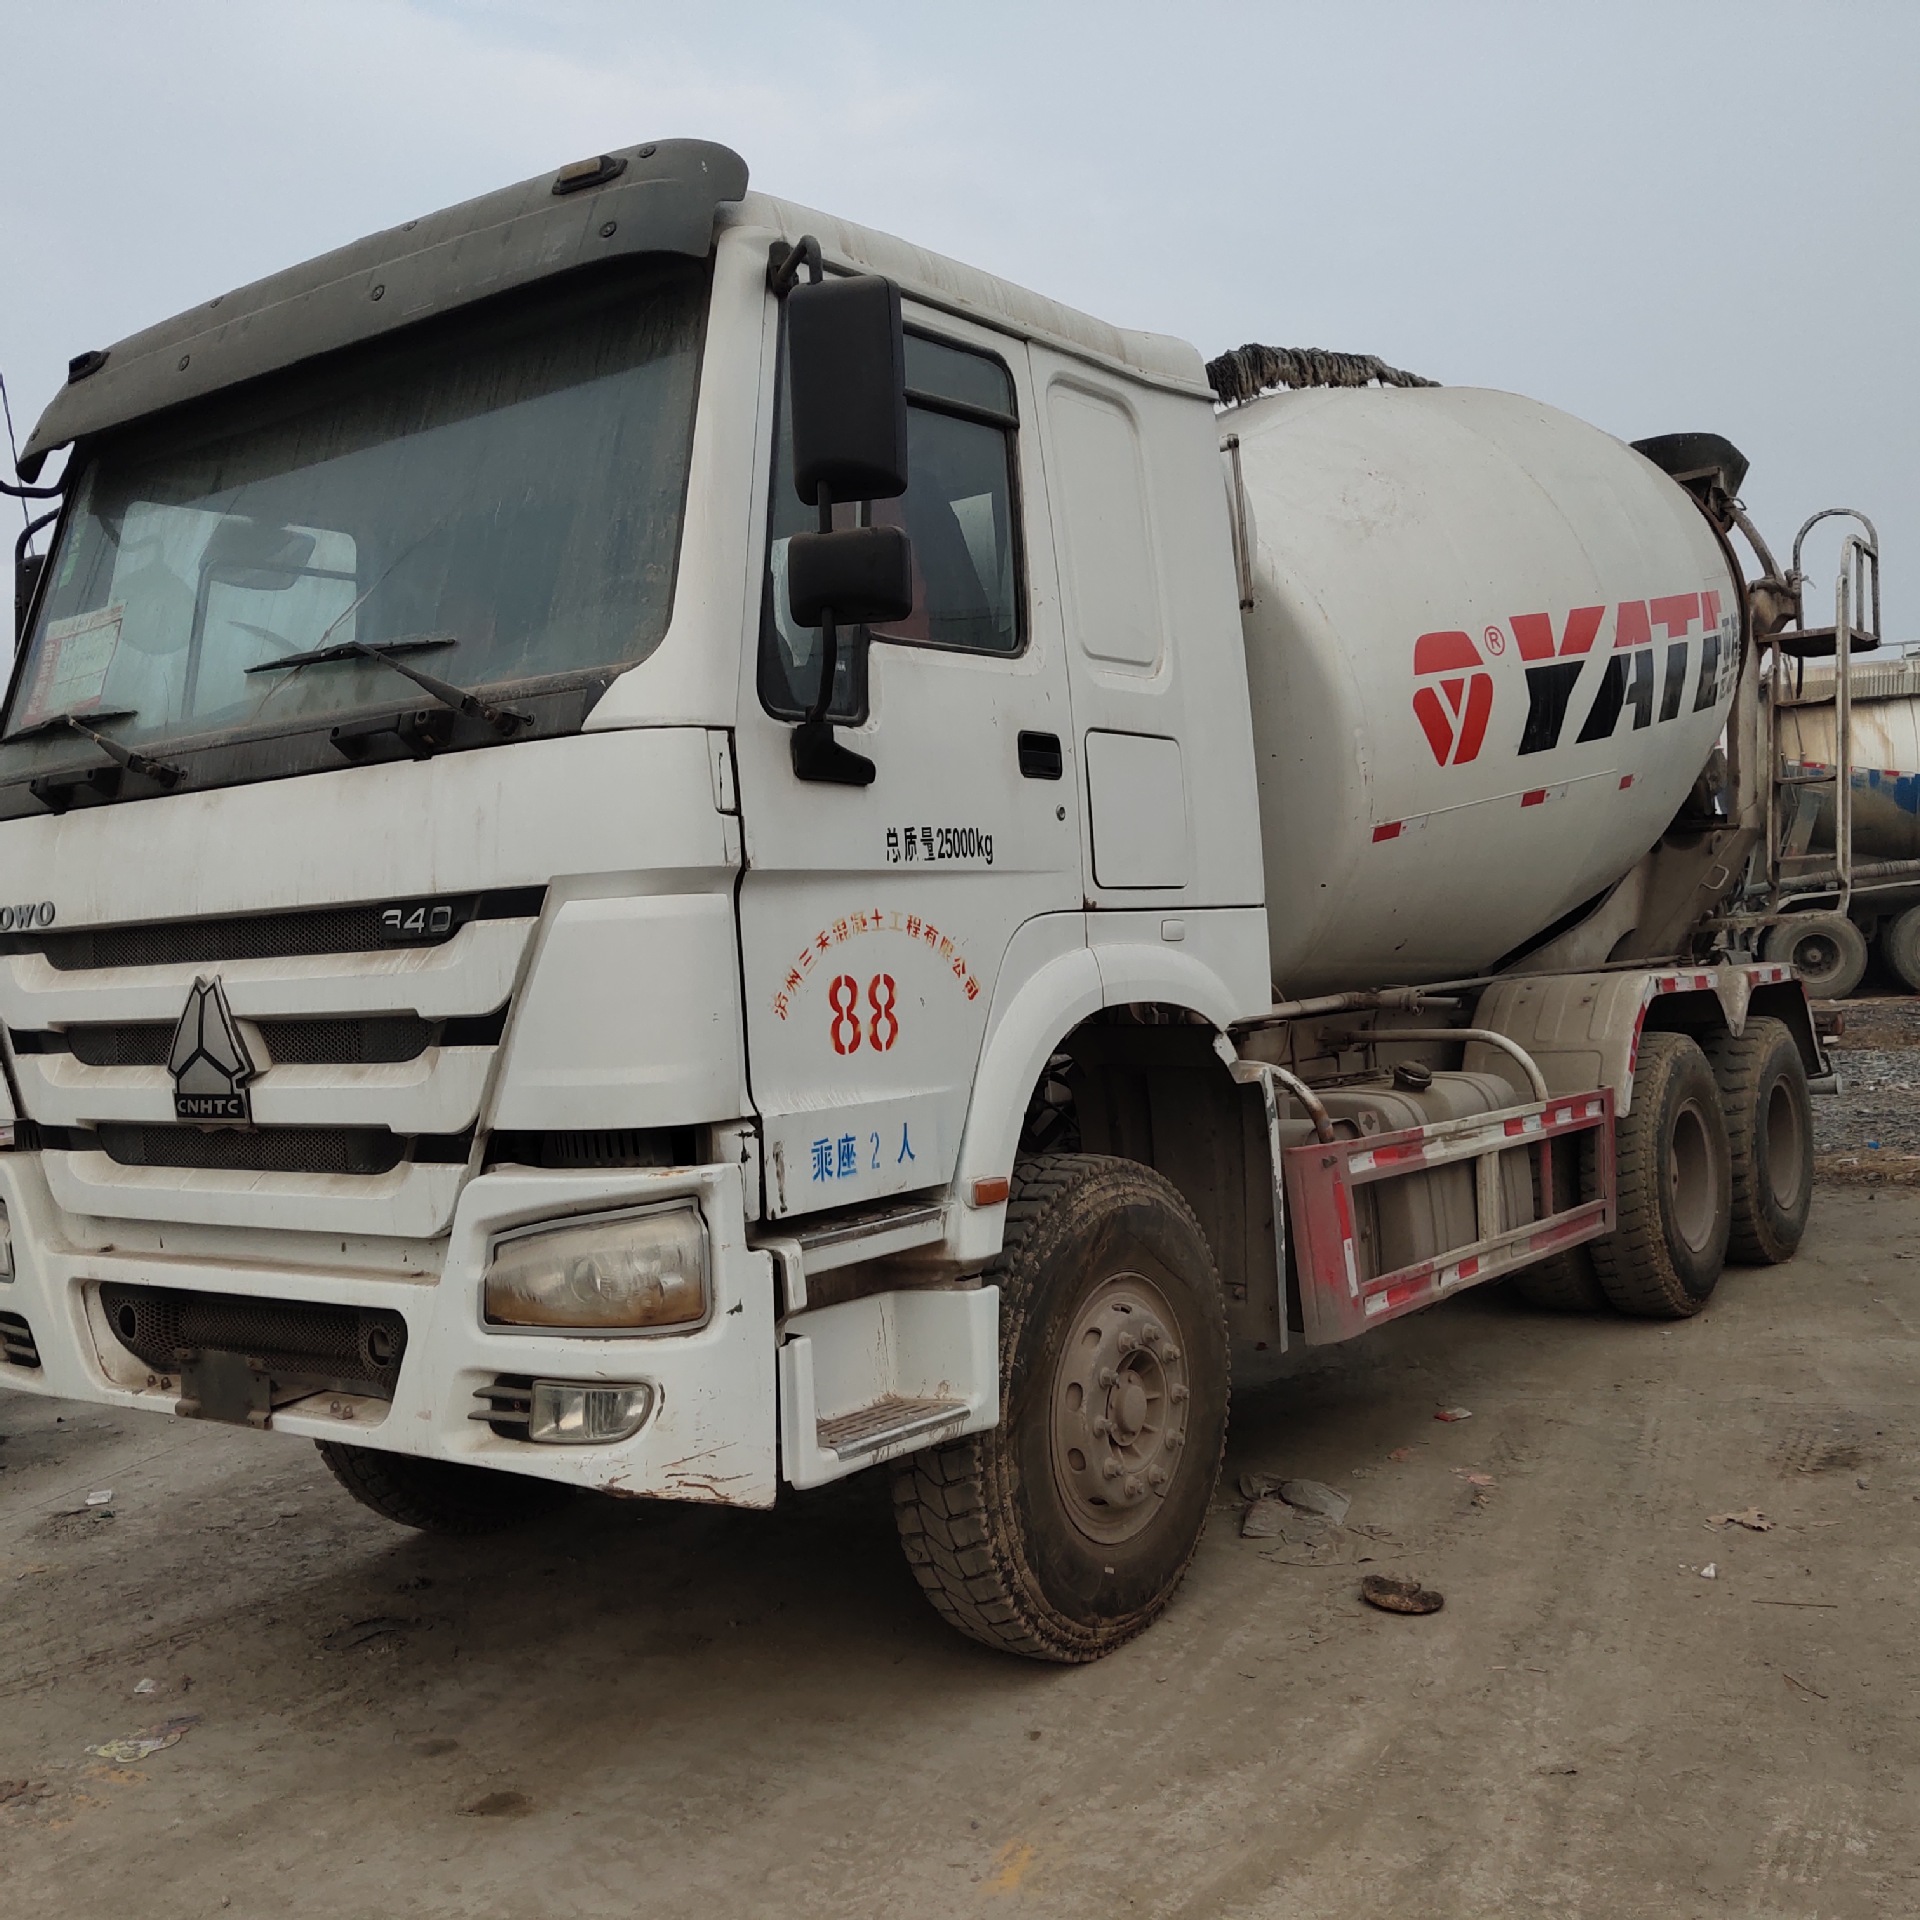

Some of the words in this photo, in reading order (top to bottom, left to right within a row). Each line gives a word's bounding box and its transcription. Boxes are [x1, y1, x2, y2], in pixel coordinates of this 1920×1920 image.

[381, 905, 453, 934] 340
[828, 973, 899, 1056] 88
[176, 1099, 239, 1115] CNHTC
